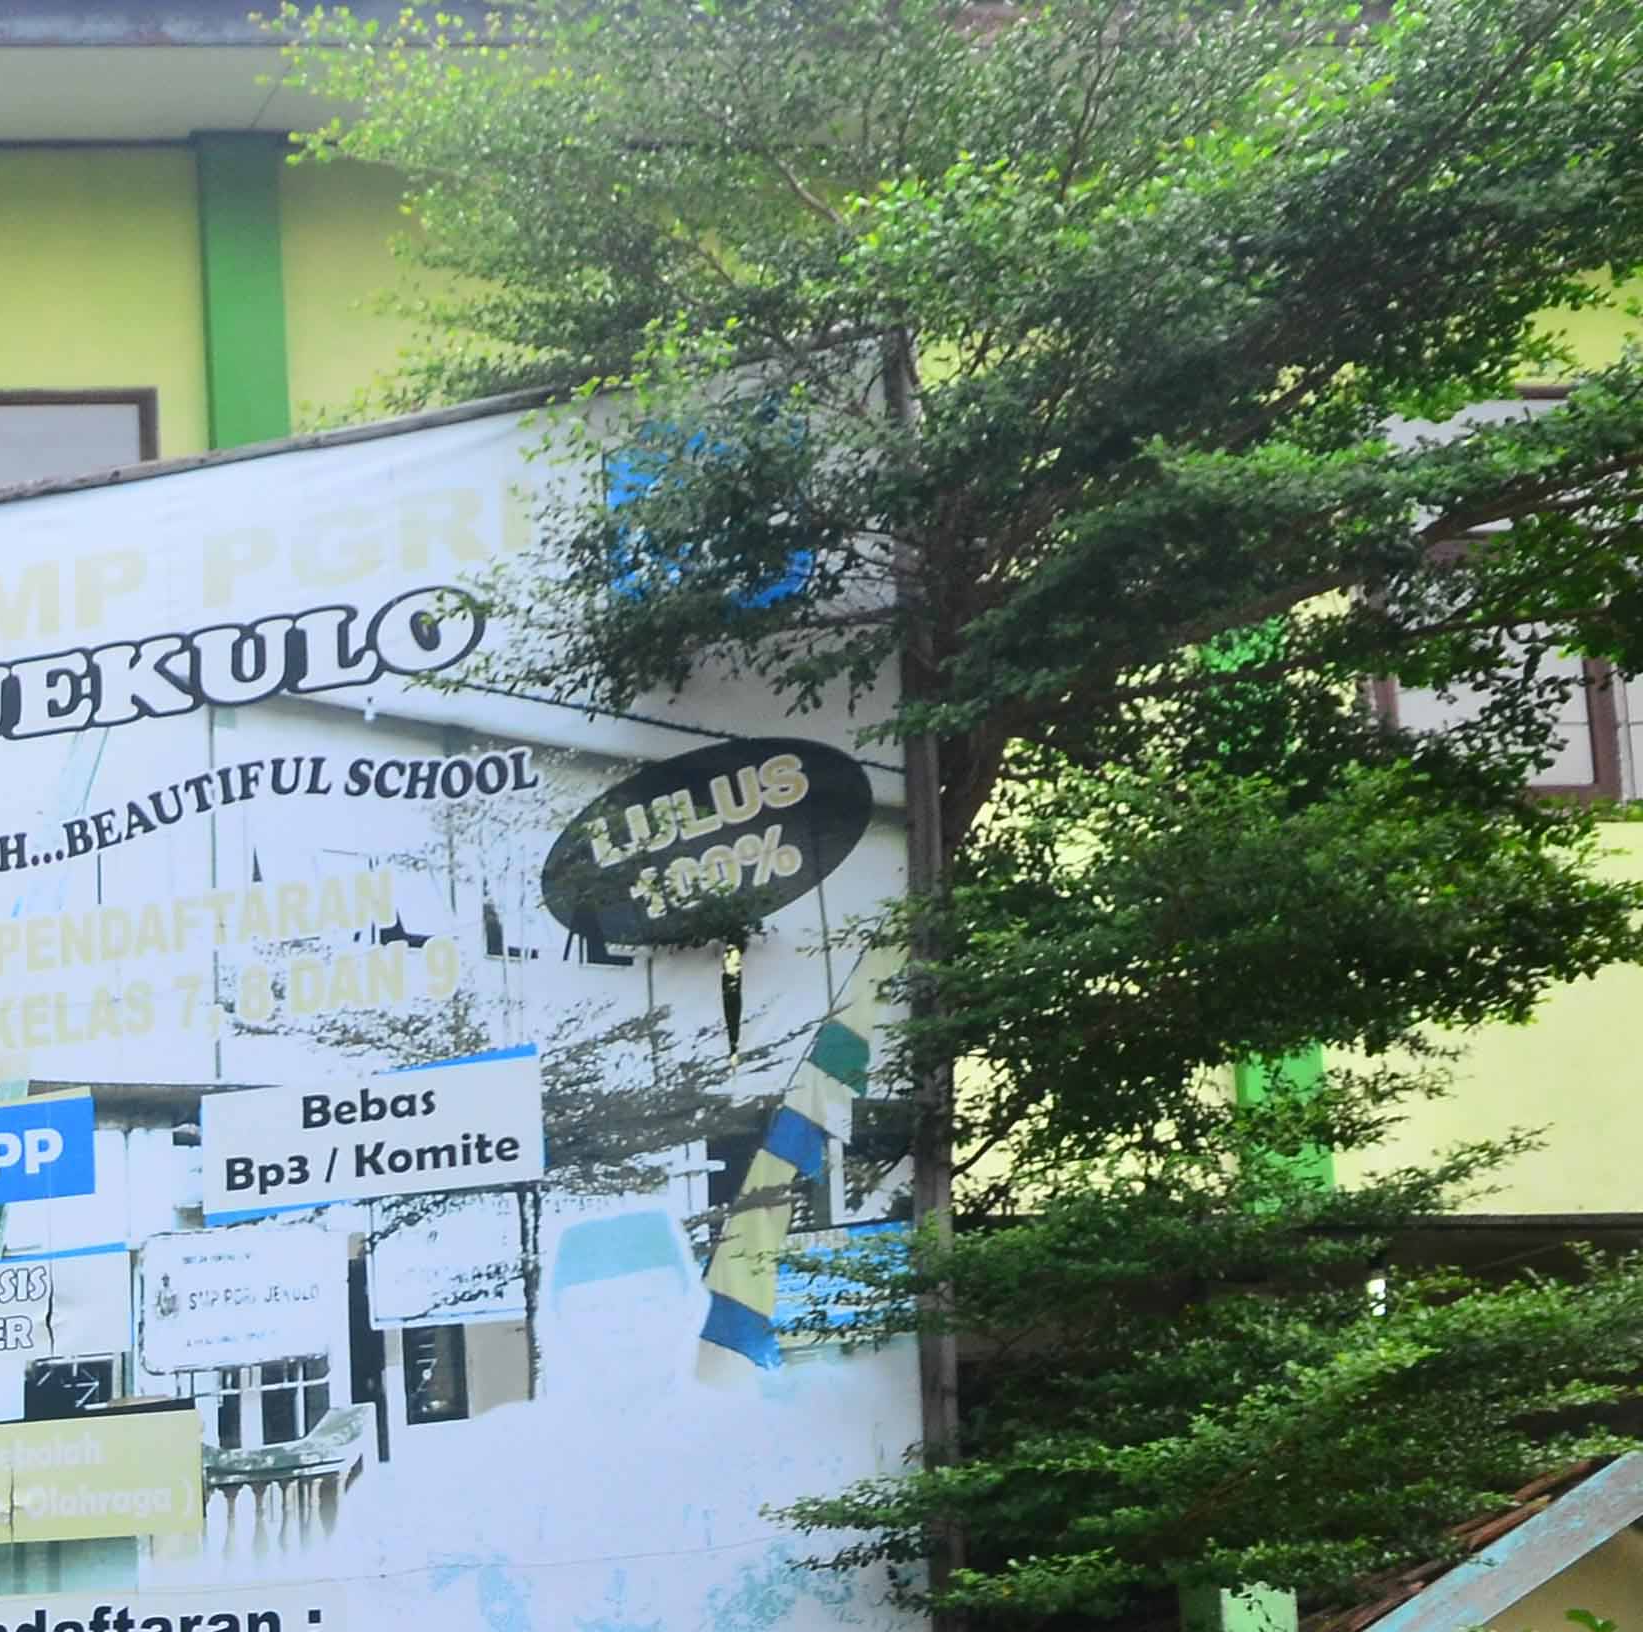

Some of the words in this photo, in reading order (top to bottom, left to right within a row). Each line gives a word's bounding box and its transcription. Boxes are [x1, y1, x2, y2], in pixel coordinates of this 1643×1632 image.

[201, 482, 532, 607] PGRI
[343, 750, 539, 801] SCHOOL
[582, 753, 810, 868] LULUS
[629, 823, 803, 919] 100%
[239, 967, 272, 1021] 8
[290, 948, 405, 1016] DAN
[426, 937, 459, 997] 9
[301, 1084, 437, 1131] Bebas
[224, 1152, 312, 1194] Bp3
[353, 1130, 521, 1178] Komite
